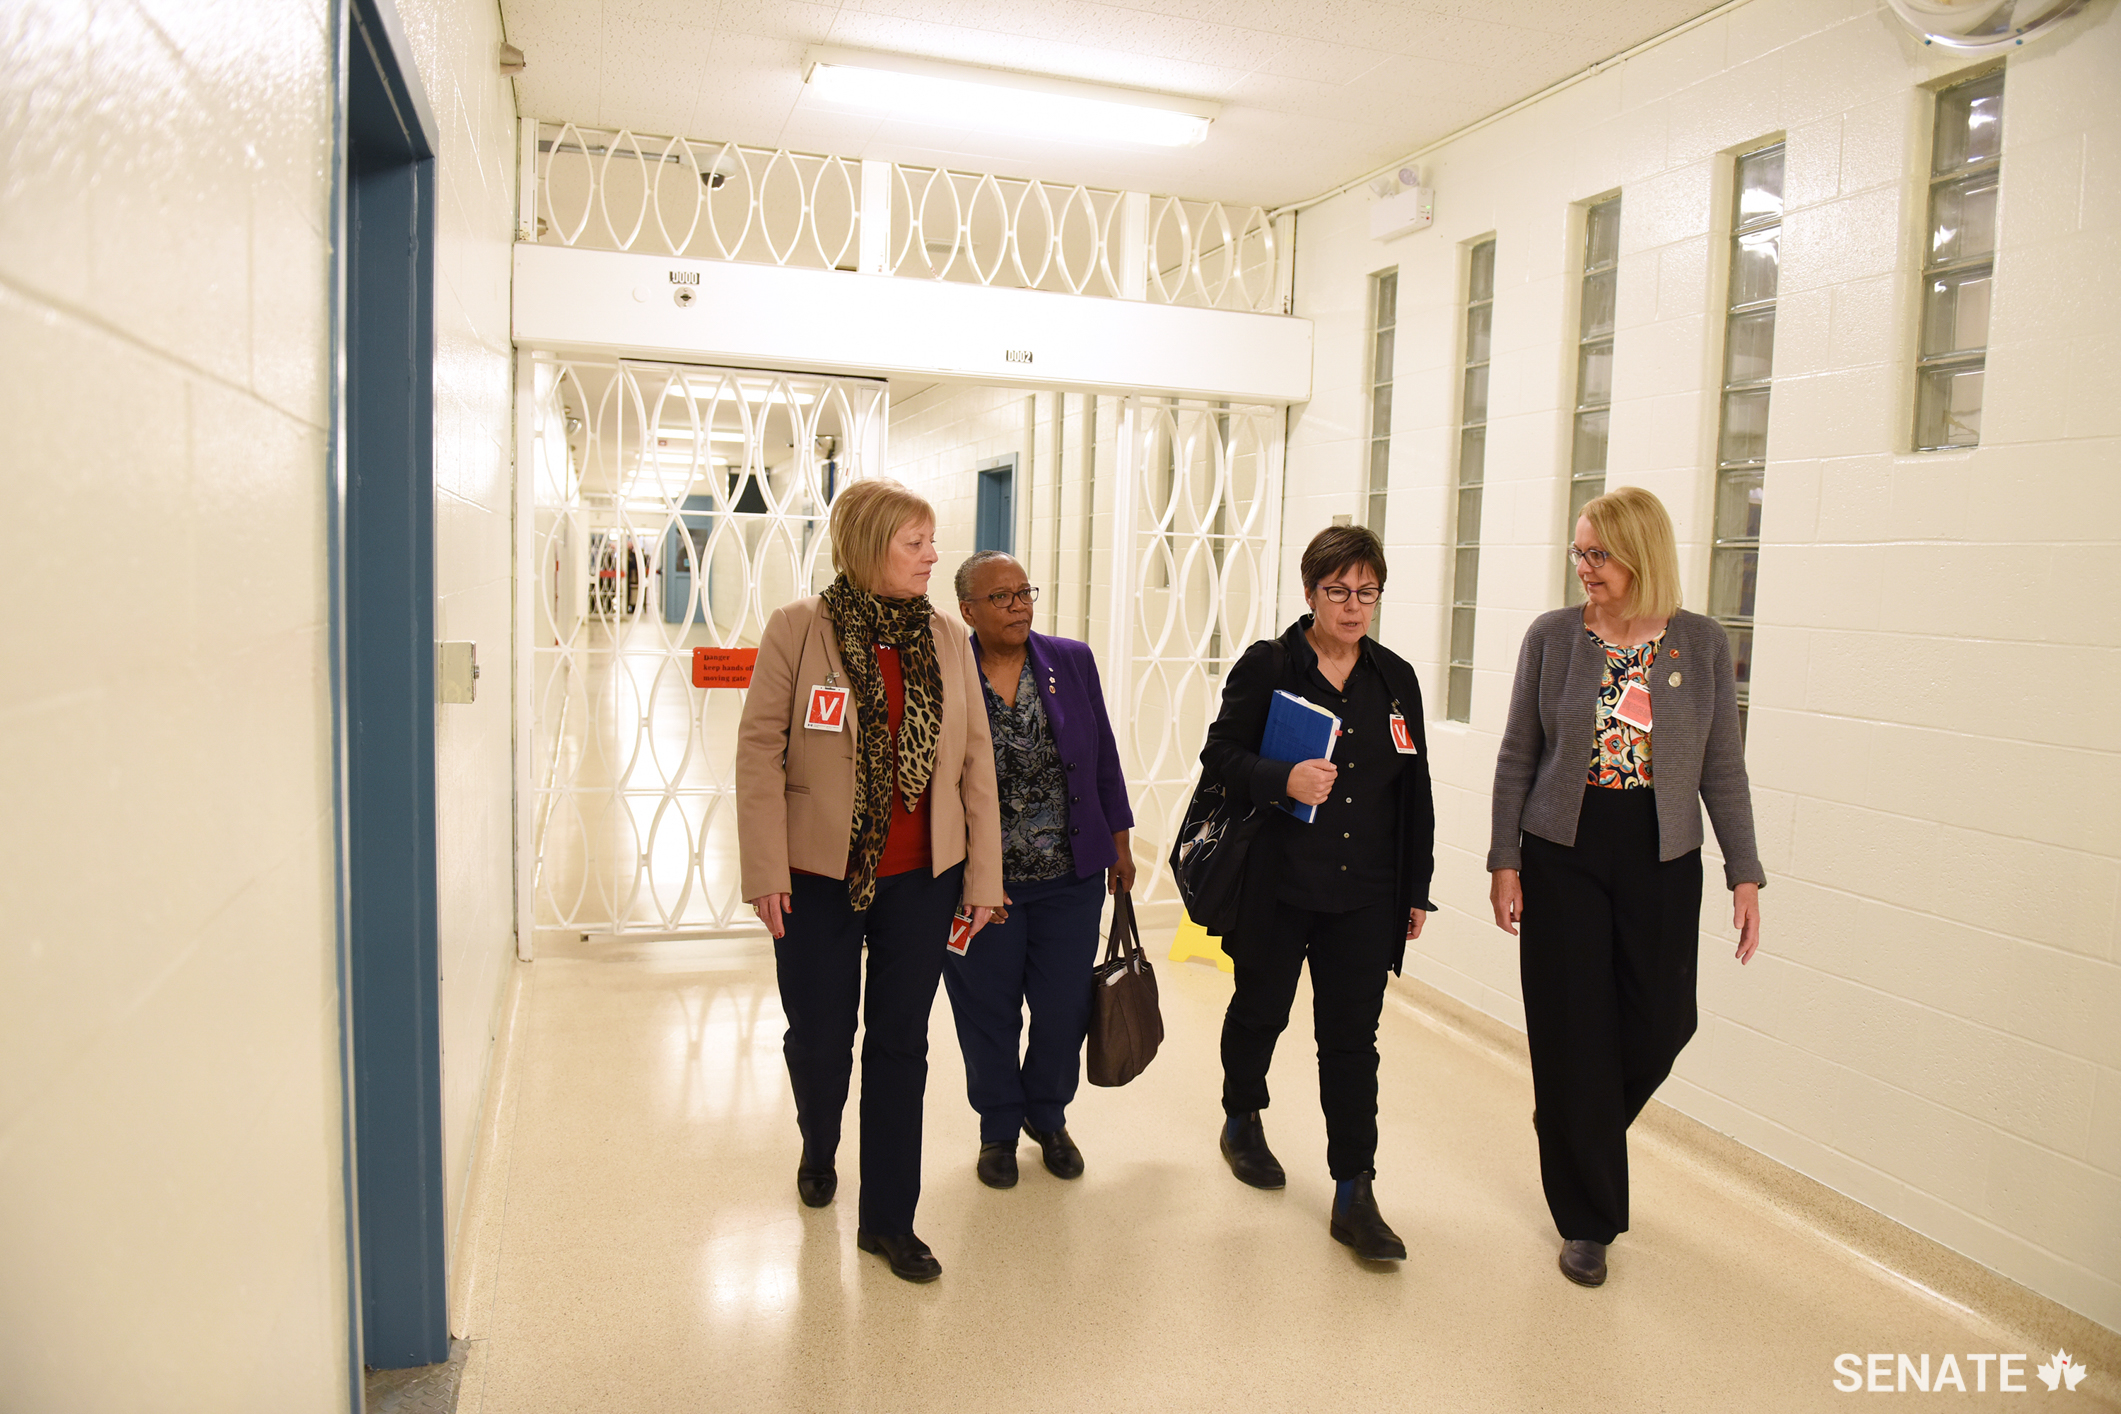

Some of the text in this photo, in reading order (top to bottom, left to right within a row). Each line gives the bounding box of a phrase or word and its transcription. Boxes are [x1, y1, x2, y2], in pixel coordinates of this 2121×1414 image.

[703, 654, 730, 662] Danger
[703, 664, 721, 672] keep
[818, 695, 840, 722] V
[1394, 723, 1407, 746] V
[949, 922, 967, 944] V
